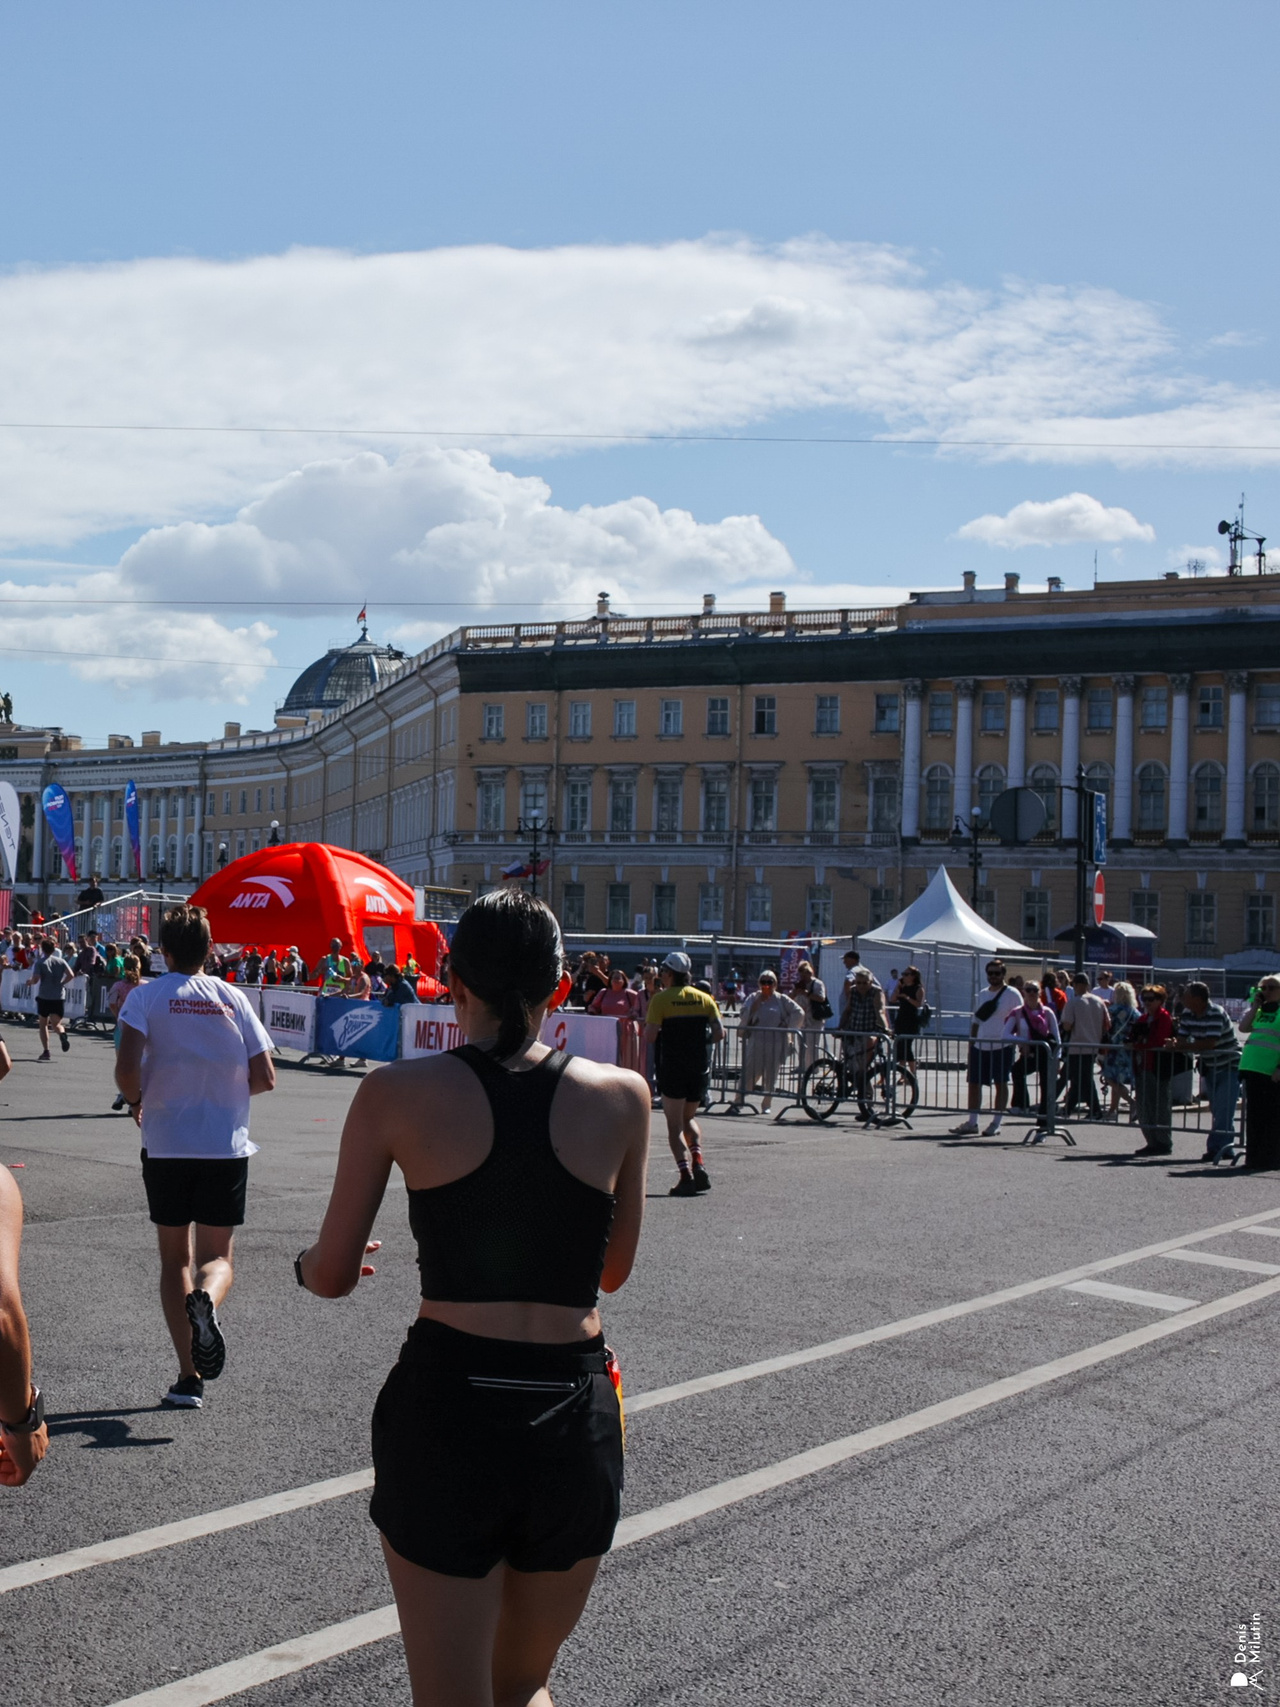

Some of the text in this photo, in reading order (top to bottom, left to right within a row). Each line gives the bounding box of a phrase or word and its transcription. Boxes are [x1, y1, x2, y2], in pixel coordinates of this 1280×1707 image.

[228, 893, 271, 909] ANTA
[365, 894, 389, 915] ANTA
[414, 1019, 444, 1050] MEN
